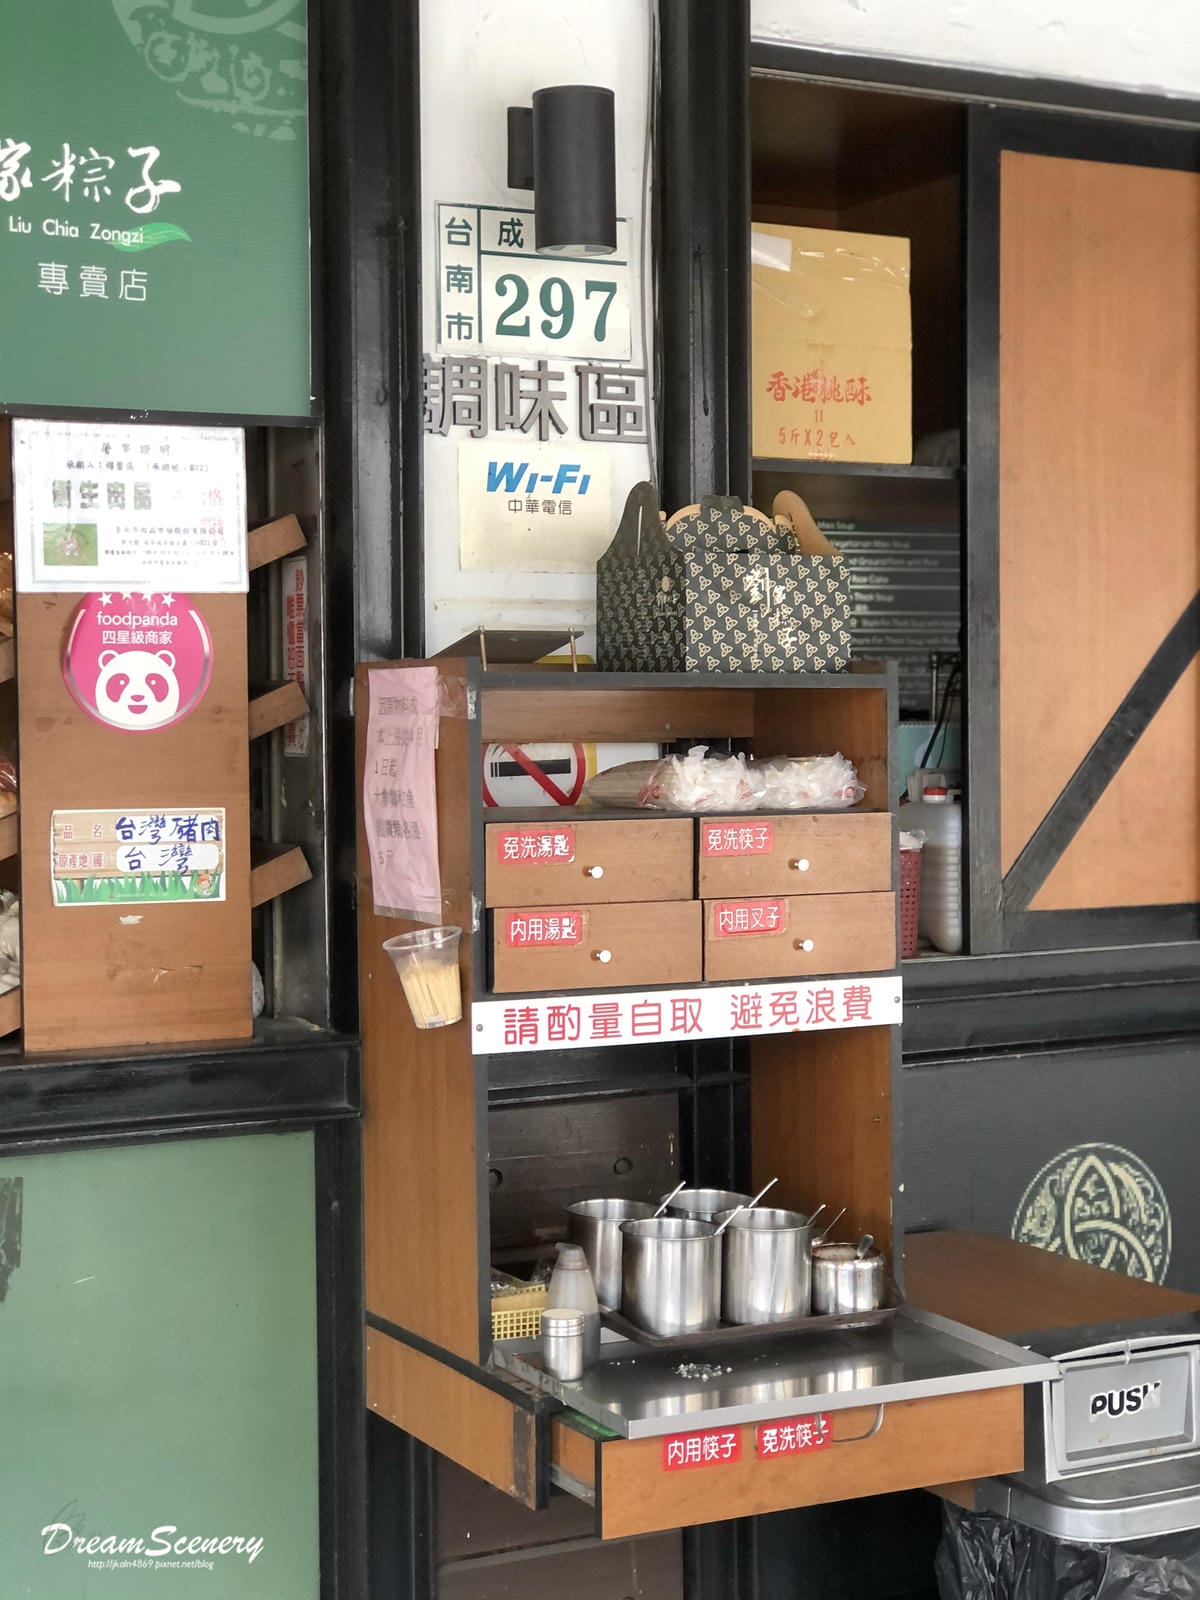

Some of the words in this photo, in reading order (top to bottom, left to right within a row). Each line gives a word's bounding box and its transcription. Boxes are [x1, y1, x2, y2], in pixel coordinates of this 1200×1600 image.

[9, 215, 32, 234] Liu
[43, 219, 80, 238] Chia
[90, 223, 144, 246] Zongzi
[38, 260, 148, 301] 專賣店
[445, 216, 474, 341] 台南市
[495, 273, 618, 342] 297
[422, 354, 649, 443] 調味區
[507, 500, 573, 516] 中華電信
[97, 611, 178, 626] foodpanda
[102, 630, 173, 645] 四星級商家
[115, 814, 220, 844] 台灣豬肉
[708, 827, 768, 851] 免洗筷子
[125, 843, 192, 874] 台灣
[504, 998, 703, 1045] 請酌量自取
[730, 985, 873, 1030] 避免浪費
[762, 1420, 830, 1453] 免洗筷子
